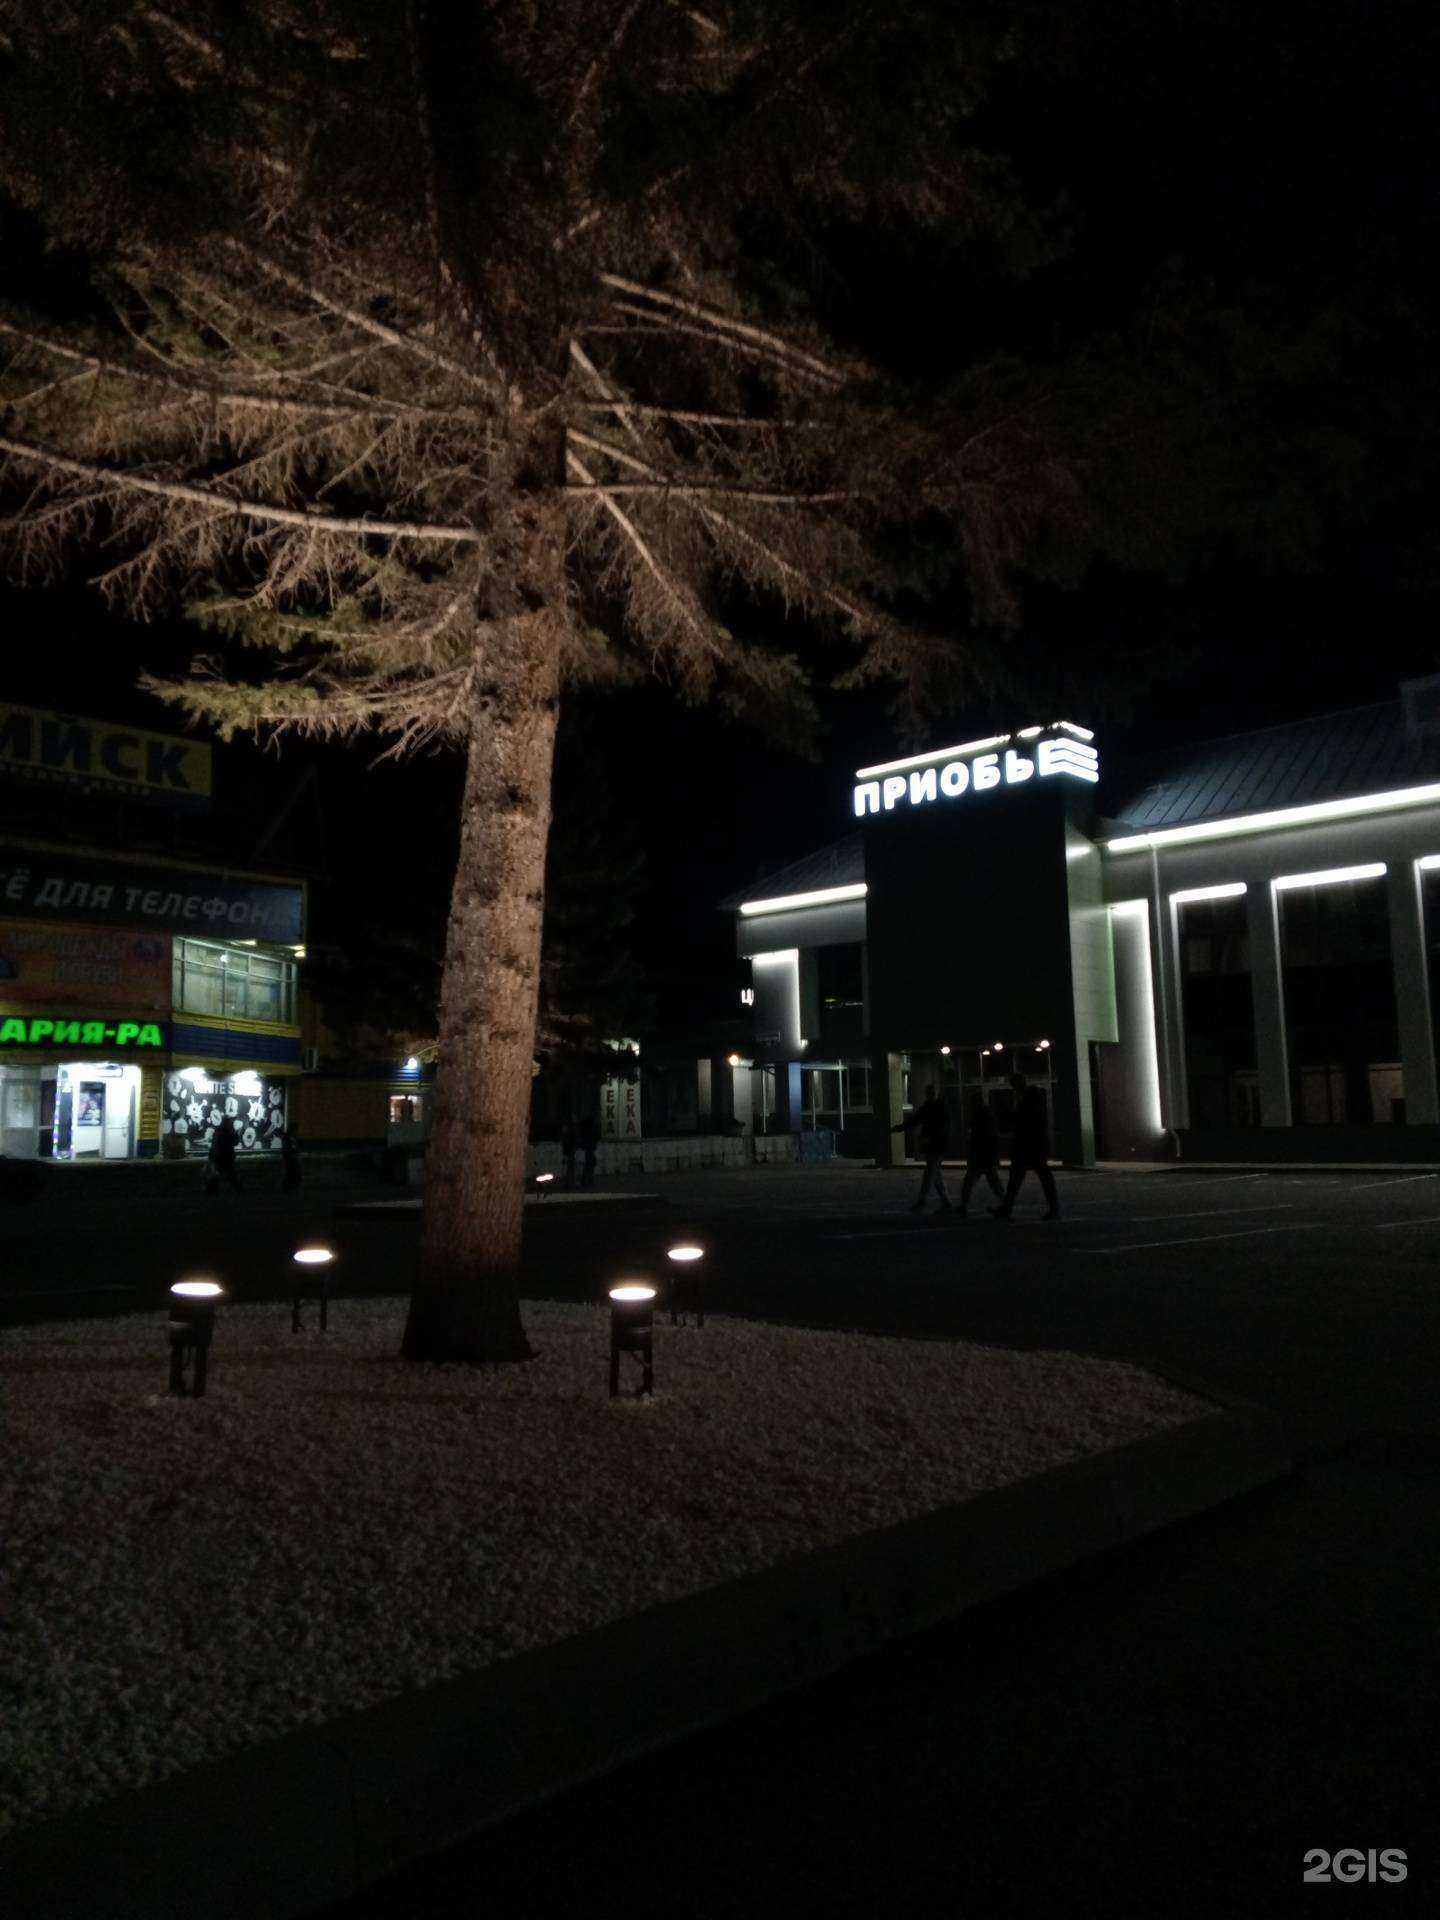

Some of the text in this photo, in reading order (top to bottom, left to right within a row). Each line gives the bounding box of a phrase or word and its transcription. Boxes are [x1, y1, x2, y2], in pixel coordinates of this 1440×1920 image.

[854, 737, 1099, 817] ПРИОБЬЕ
[0, 867, 30, 900] Ё
[33, 877, 114, 911] ДЛЯ
[0, 1018, 163, 1047] АРИЯ-РА
